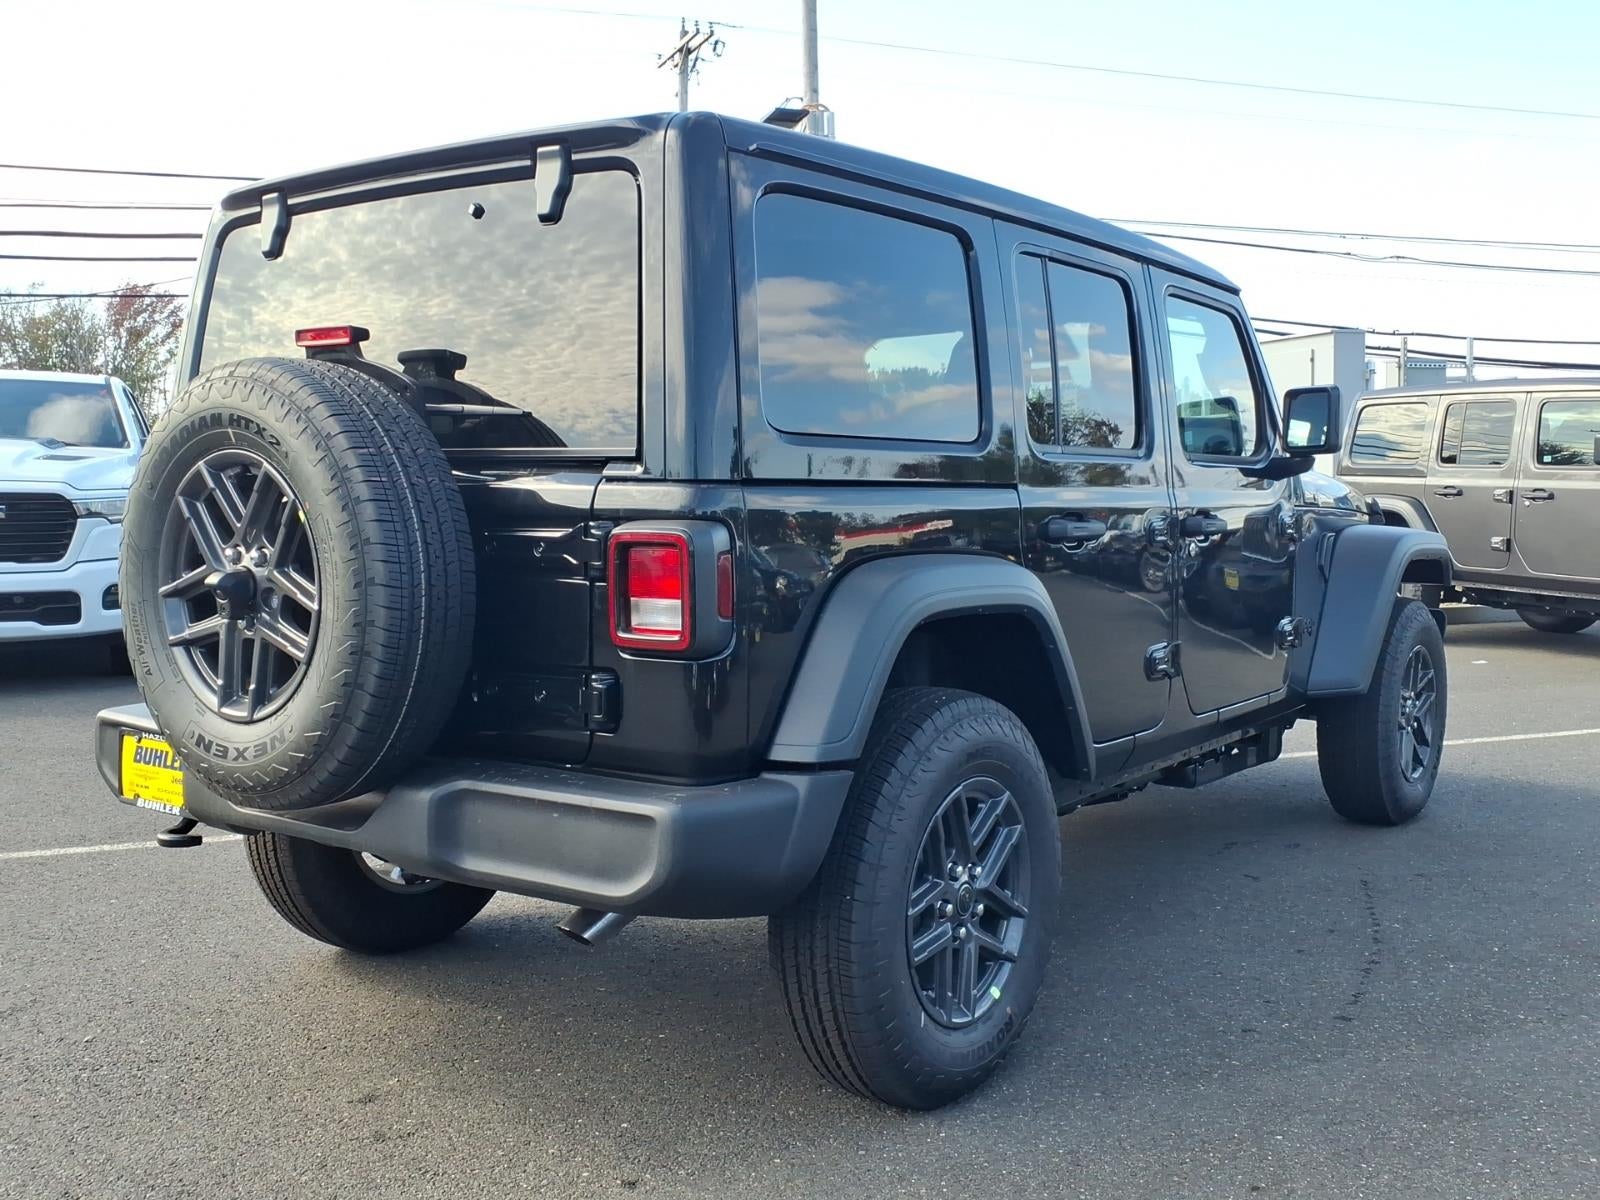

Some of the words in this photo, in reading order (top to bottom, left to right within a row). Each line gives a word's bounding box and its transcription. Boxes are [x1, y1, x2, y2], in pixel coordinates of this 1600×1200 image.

[228, 413, 281, 452] HTX2
[131, 602, 153, 676] All-Weather
[142, 731, 167, 742] HAZL
[195, 729, 286, 761] NEXEN
[171, 776, 183, 785] Jee
[137, 798, 180, 816] BUHLER
